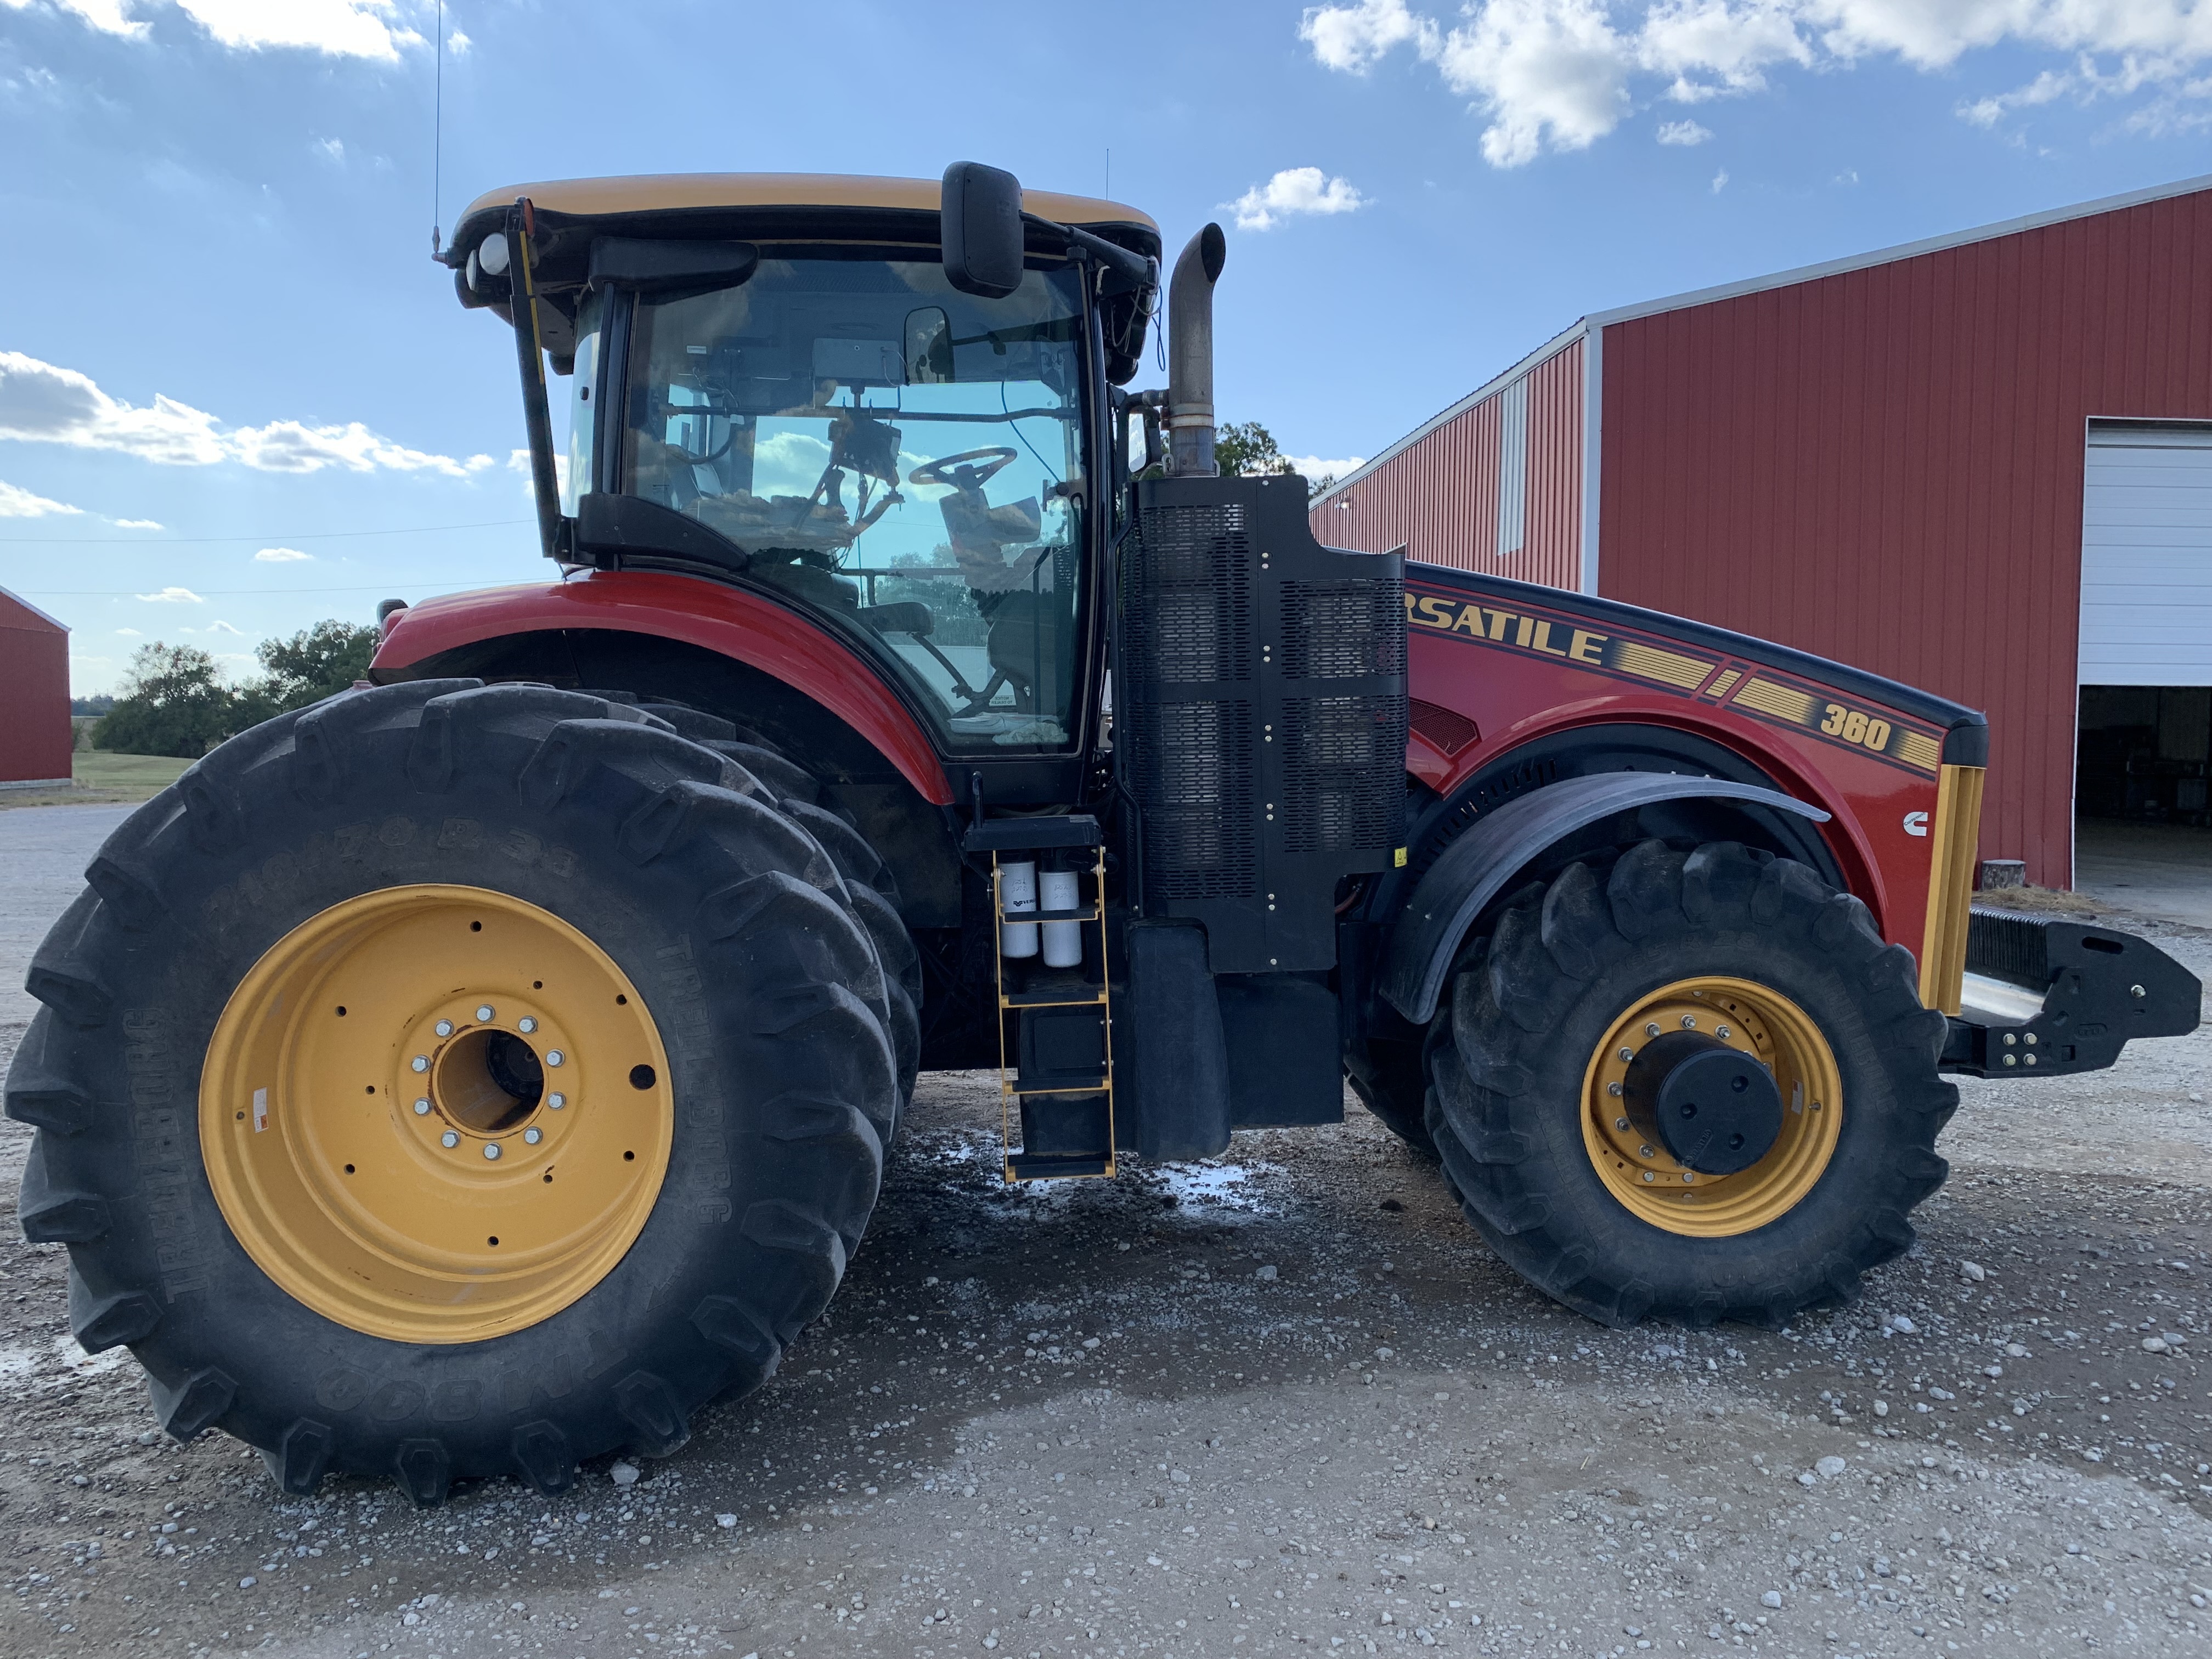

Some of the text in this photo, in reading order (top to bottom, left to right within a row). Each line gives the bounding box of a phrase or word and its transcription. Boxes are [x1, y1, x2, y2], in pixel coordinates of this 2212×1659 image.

[1821, 704, 1891, 751] 360
[1904, 812, 1926, 826] Cummins
[122, 1007, 212, 1305] TRELLEBORG
[655, 933, 733, 1226] TRELLEBORG
